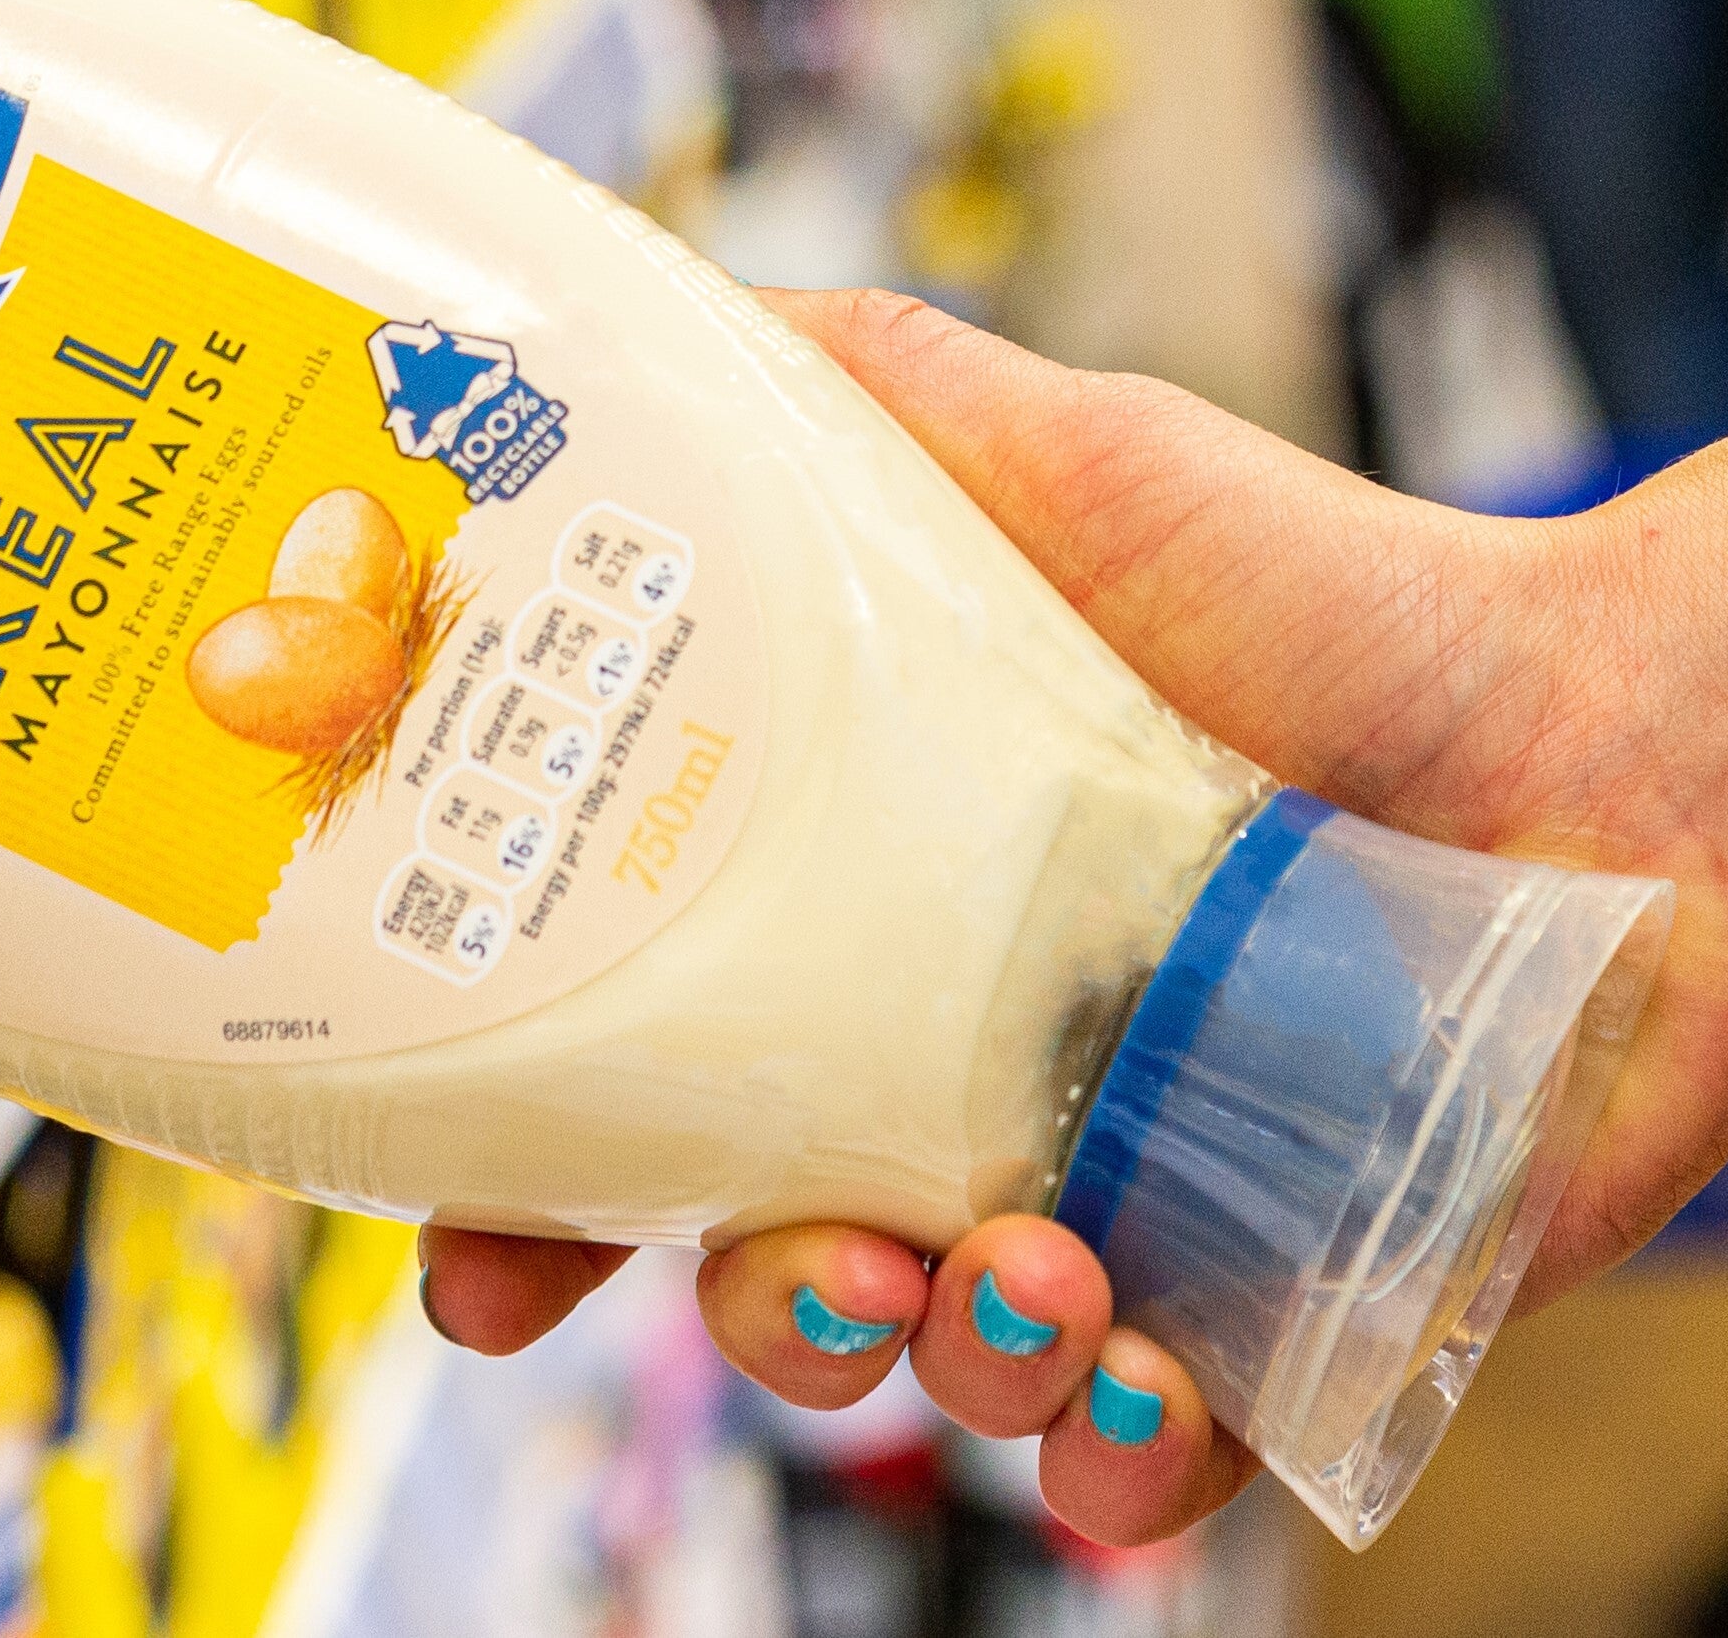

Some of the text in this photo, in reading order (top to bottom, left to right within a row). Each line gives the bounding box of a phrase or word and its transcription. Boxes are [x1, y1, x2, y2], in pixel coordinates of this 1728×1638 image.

[449, 388, 541, 475] 100%
[466, 402, 566, 502] RECYCLABLE
[500, 432, 562, 495] BOTTLE
[0, 329, 247, 763] MAYONNAISE
[87, 425, 248, 705] 100% Free Range Eggs
[575, 531, 608, 570] Salt
[598, 538, 643, 589] 0.21g
[71, 346, 333, 824] Committed to sustainably sourced oils
[520, 607, 567, 669] Sugars
[405, 751, 433, 788] Per
[427, 677, 473, 754] portion
[471, 685, 526, 765] Saturates
[509, 717, 547, 758] 0.9g
[440, 795, 471, 830] Fat
[468, 808, 503, 841] 11g
[610, 720, 736, 896] 750ml
[383, 867, 432, 935] Energy
[519, 868, 571, 940] Energy
[560, 829, 586, 869] per
[223, 1019, 331, 1042] 68879614
